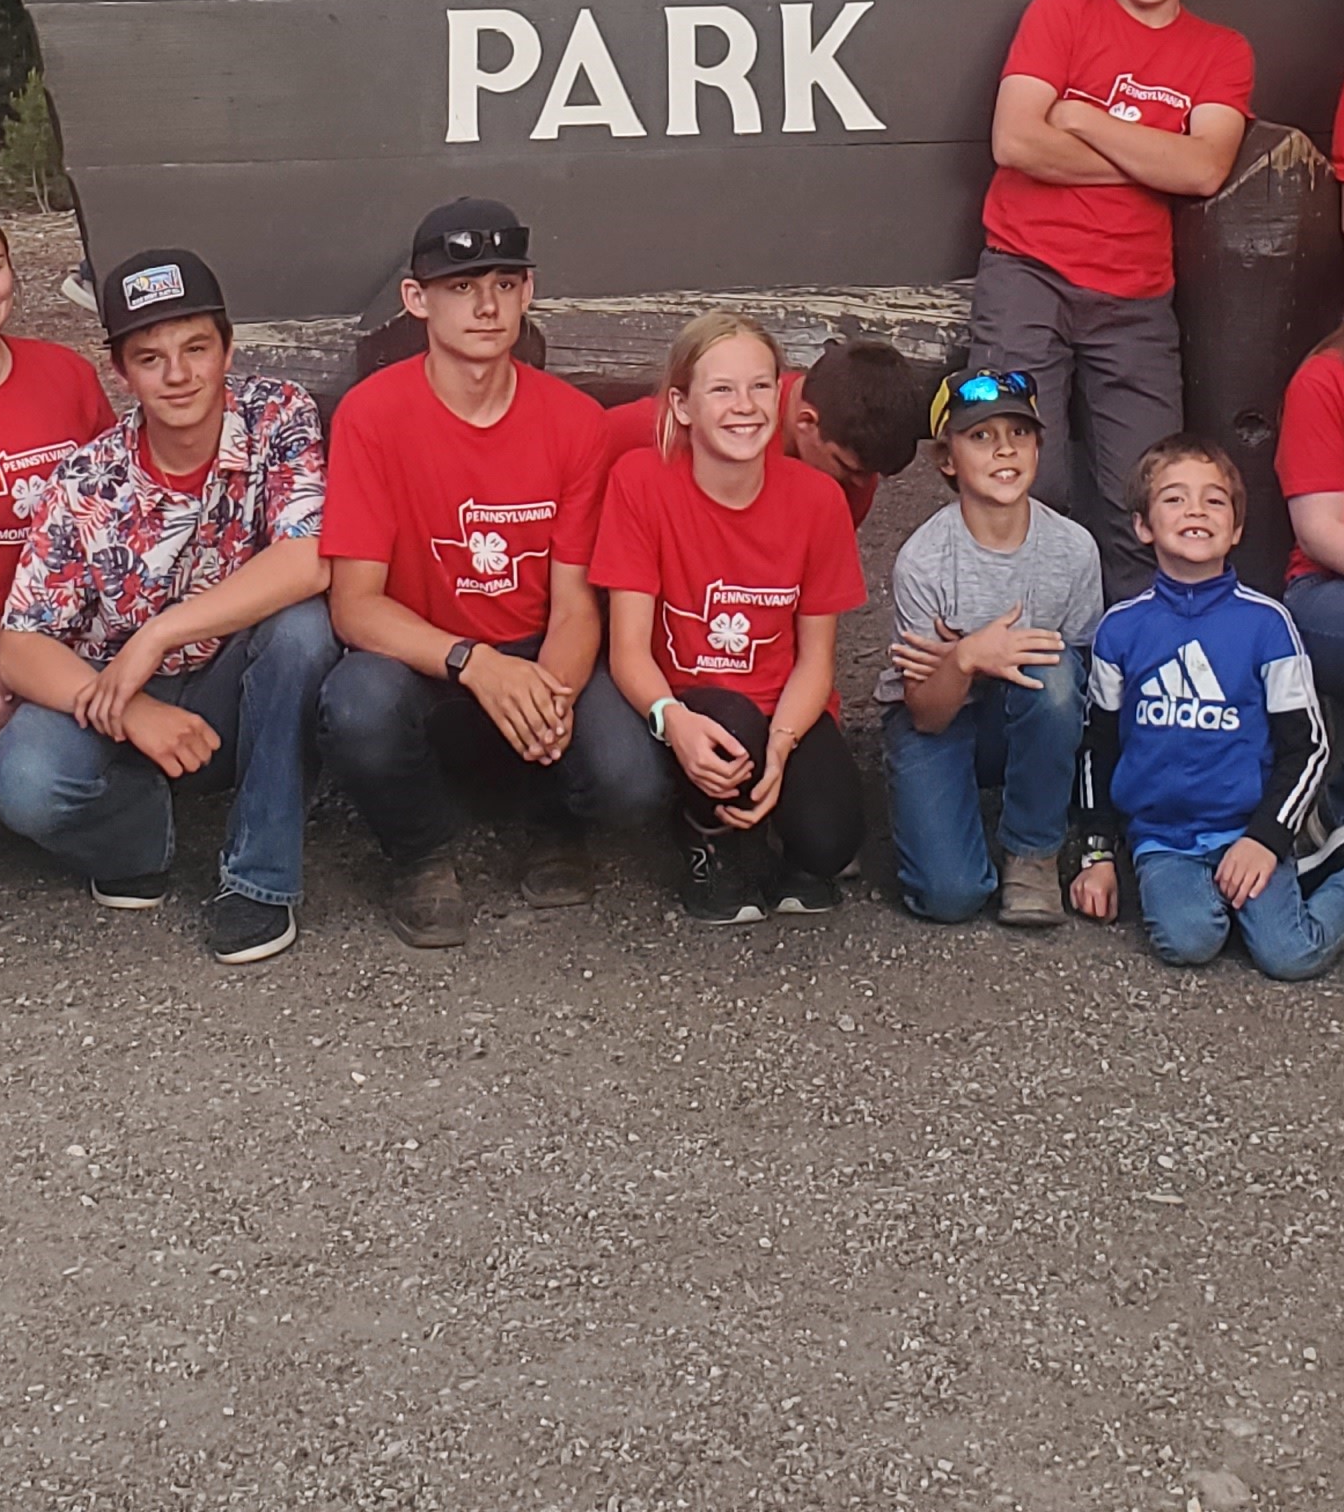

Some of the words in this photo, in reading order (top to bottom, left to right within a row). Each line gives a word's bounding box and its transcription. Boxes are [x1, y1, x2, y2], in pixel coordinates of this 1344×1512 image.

[446, 2, 886, 142] PARK
[2, 446, 74, 473] PENNSYLVA
[466, 508, 552, 524] PENNSYLVANIA
[456, 577, 513, 593] MONTNA
[713, 591, 796, 606] PENNSYLVAN
[1136, 694, 1241, 730] adidas
